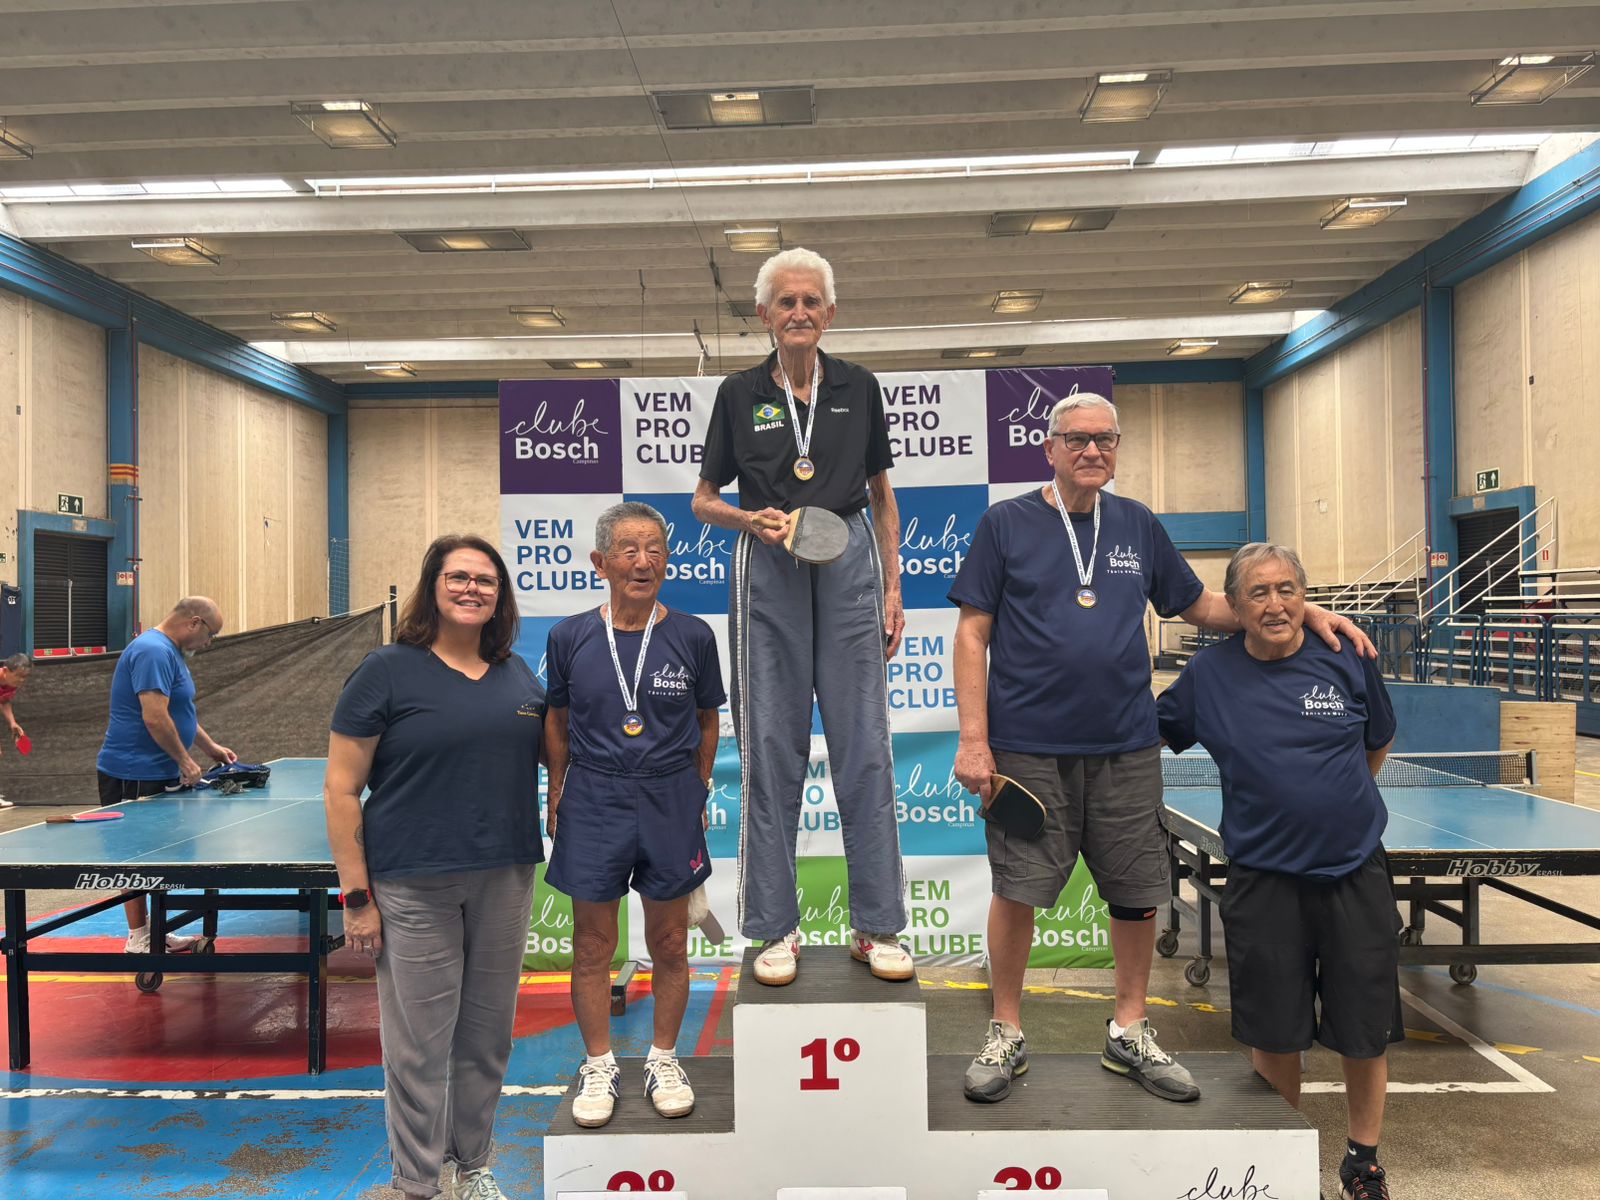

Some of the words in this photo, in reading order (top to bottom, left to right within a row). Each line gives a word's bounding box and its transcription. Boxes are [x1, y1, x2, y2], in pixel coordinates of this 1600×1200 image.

[634, 392, 692, 412] VEM
[882, 384, 941, 406] VEM
[504, 398, 609, 437] clube
[636, 418, 691, 438] PRO
[754, 421, 784, 432] BRASIL
[885, 411, 940, 432] PRO
[515, 436, 599, 460] Bosch
[636, 444, 704, 464] CLUB
[889, 435, 973, 458] CLUBE
[515, 519, 573, 539] VEM
[898, 513, 971, 552] lube
[666, 522, 732, 558] lube
[517, 545, 572, 565] PRO
[1105, 544, 1142, 560] clube
[665, 557, 725, 580] osch
[1110, 558, 1140, 569] Bosch
[517, 570, 605, 591] CLUBE
[653, 677, 687, 689] Bosch
[888, 662, 943, 683] PRO
[889, 688, 957, 709] CLUB
[1298, 685, 1344, 702] clube
[1304, 699, 1344, 709] Bosch
[1446, 860, 1540, 877] Hobby
[75, 873, 164, 890] Hobby
[911, 880, 950, 901] EM
[912, 907, 950, 928] RO
[525, 932, 573, 954] Bos
[800, 1037, 860, 1090] 1º
[1176, 1165, 1279, 1200] clube
